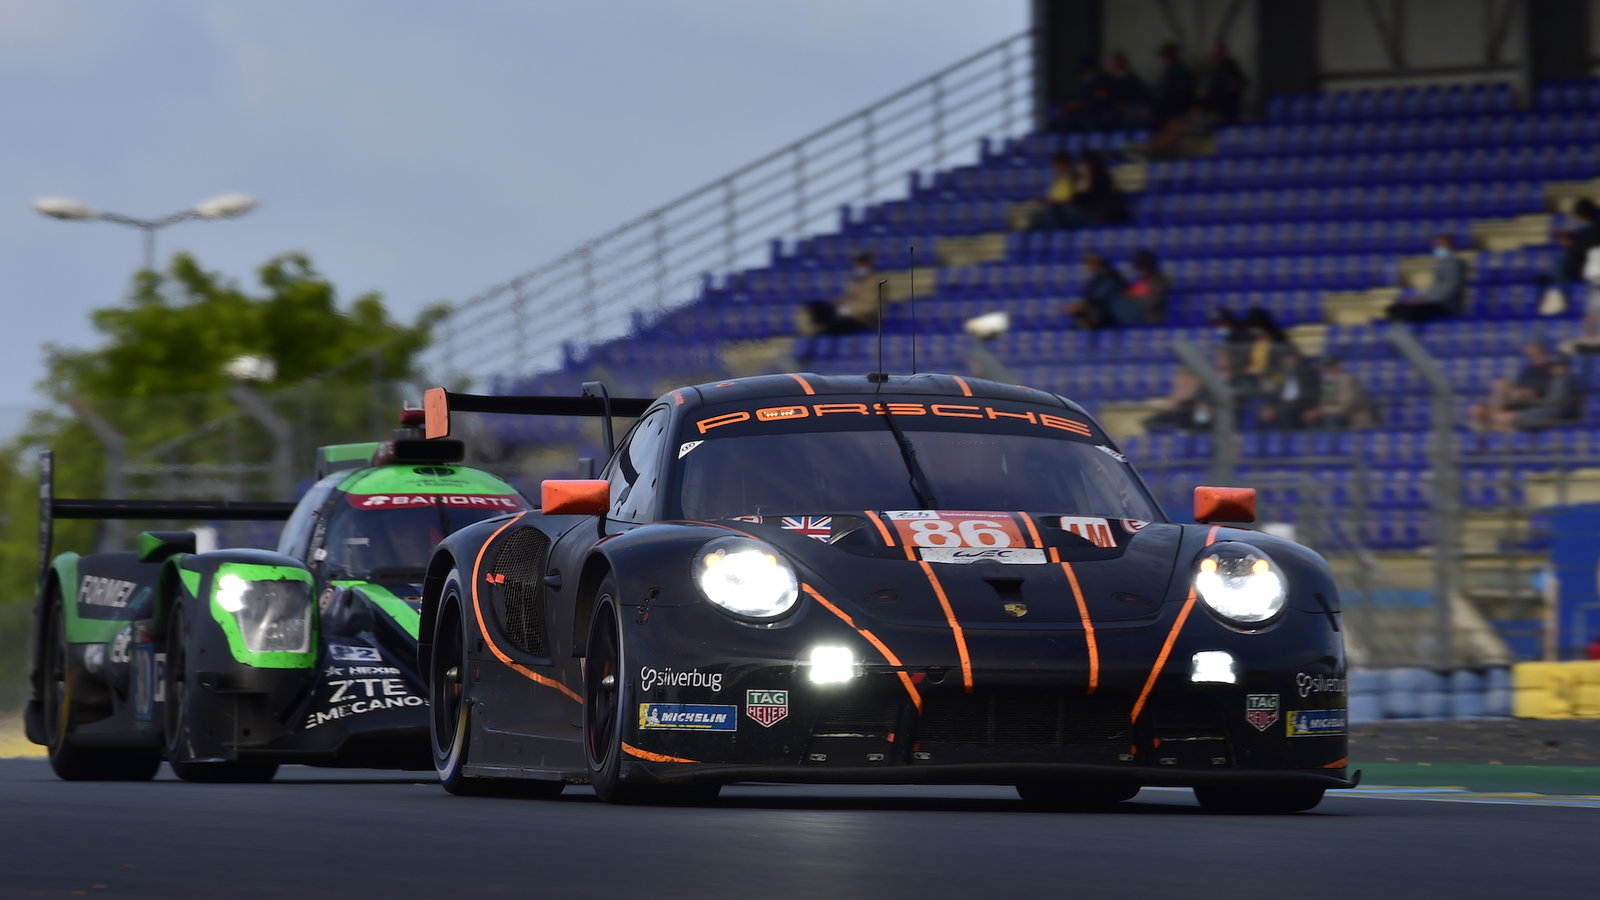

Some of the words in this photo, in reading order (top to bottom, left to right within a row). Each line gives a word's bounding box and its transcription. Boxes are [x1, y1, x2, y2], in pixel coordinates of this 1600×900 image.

[696, 403, 1093, 436] PORSCHE
[391, 495, 516, 507] BANORTE
[909, 520, 1011, 548] 86
[952, 549, 1012, 559] WEC
[657, 667, 722, 691] silverbug
[328, 678, 408, 703] ZTE
[752, 692, 785, 704] TAG
[1249, 697, 1277, 707] TAG
[661, 712, 727, 723] MICHELIN
[750, 706, 786, 724] HEUER
